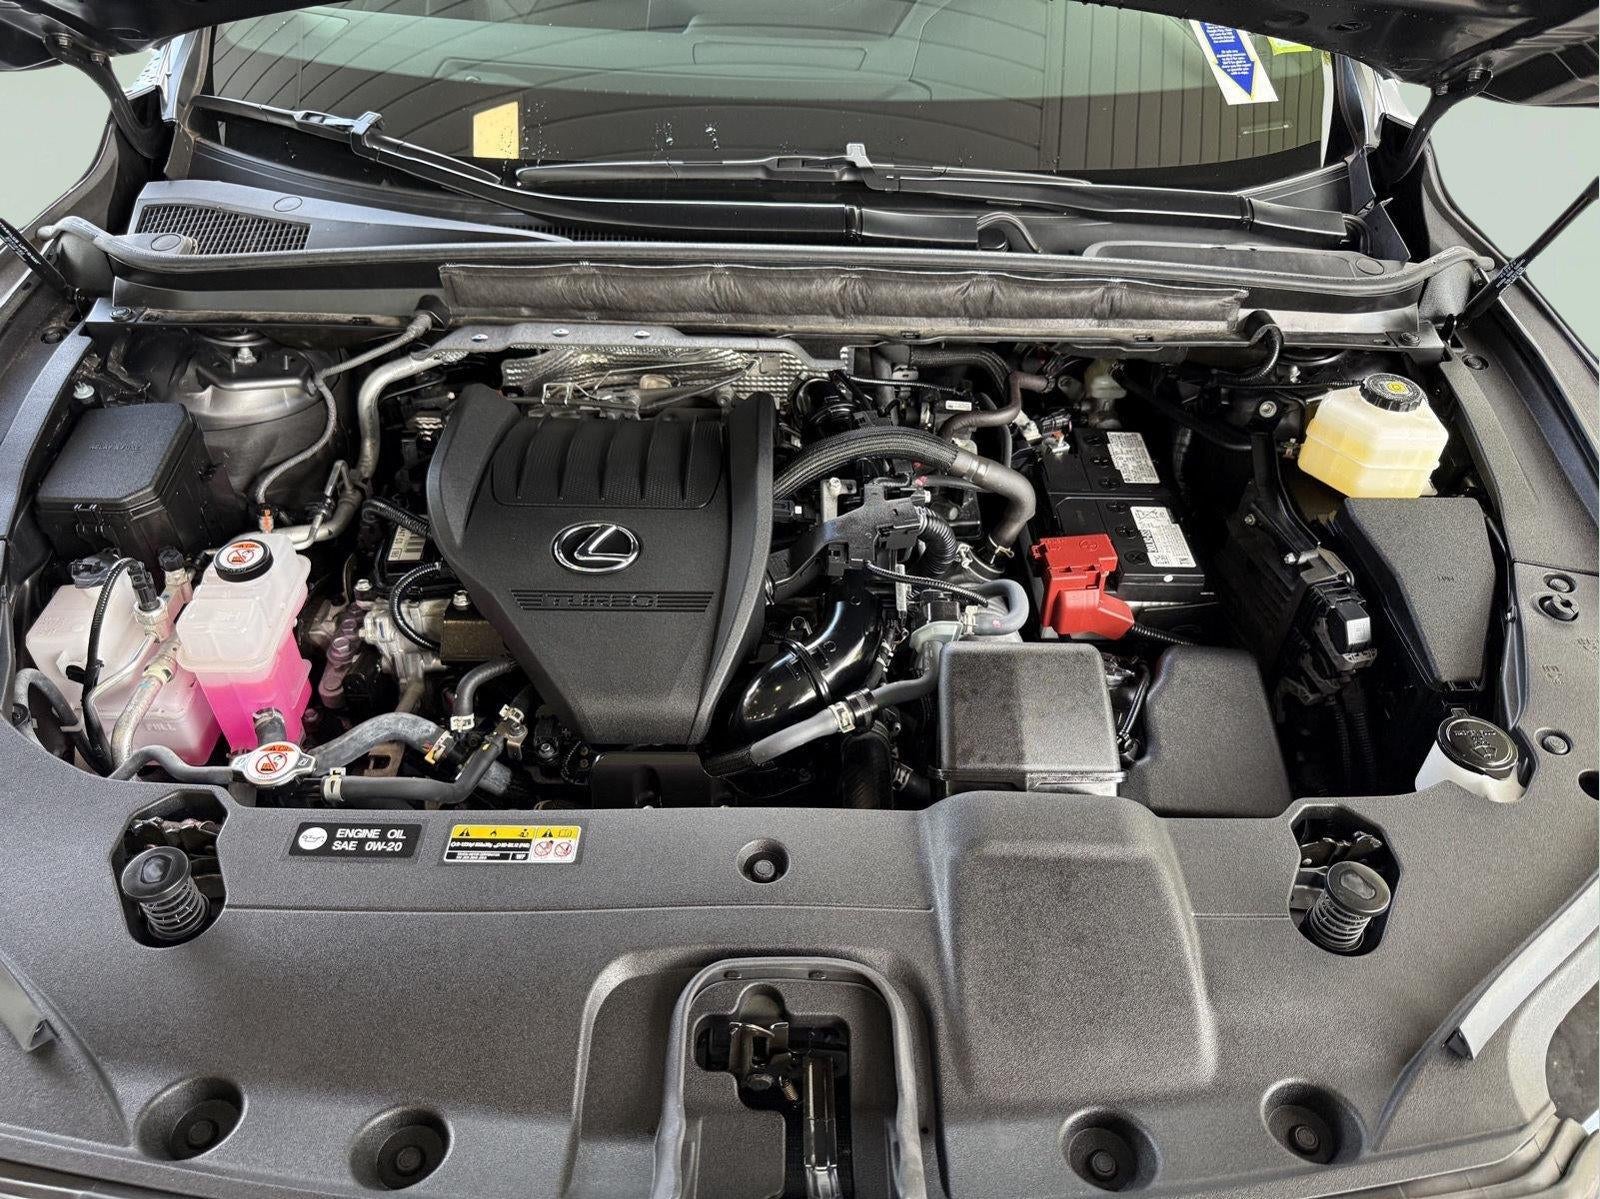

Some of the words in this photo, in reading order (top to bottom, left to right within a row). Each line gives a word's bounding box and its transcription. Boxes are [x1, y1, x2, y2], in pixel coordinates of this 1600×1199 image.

[335, 828, 381, 839] ENGINE
[387, 829, 407, 839] OIL
[332, 840, 358, 851] SAE
[365, 841, 403, 852] 0W-20
